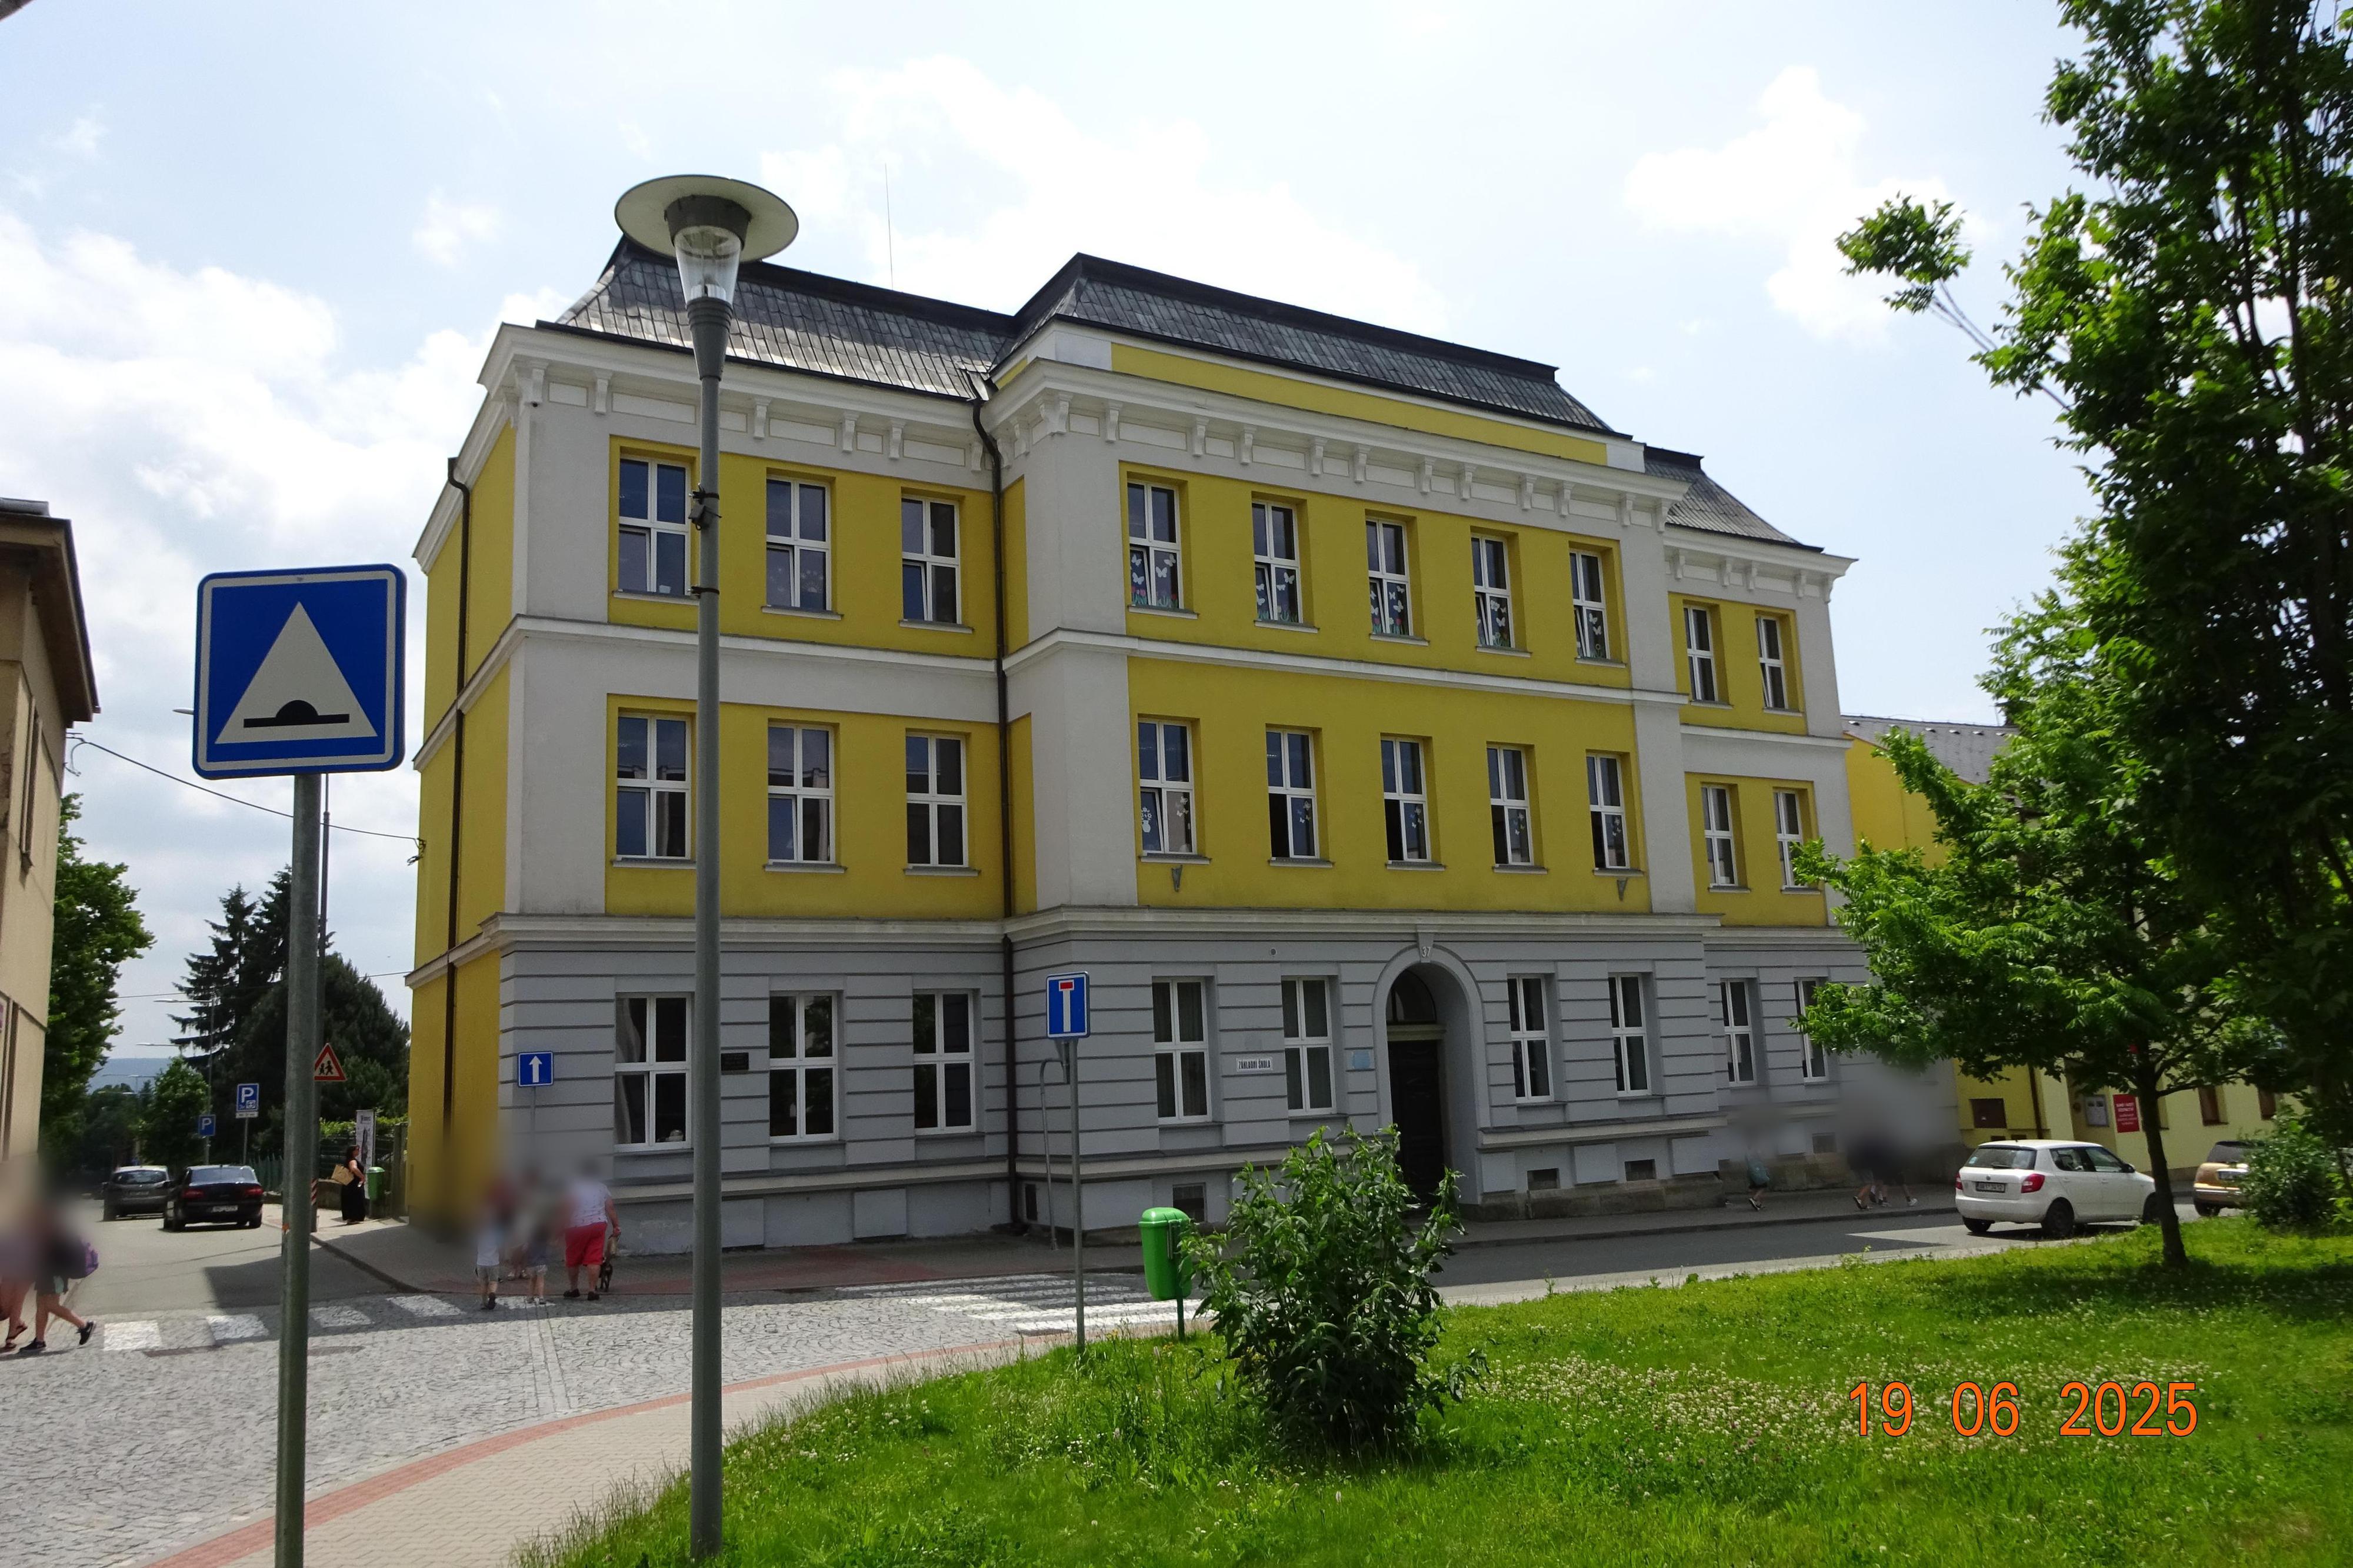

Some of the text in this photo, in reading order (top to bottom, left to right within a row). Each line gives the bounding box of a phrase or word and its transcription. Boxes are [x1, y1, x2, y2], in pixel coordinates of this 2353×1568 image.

[1258, 1059, 1271, 1068] ŠKOLA
[241, 1087, 254, 1103] P
[202, 1117, 211, 1130] P
